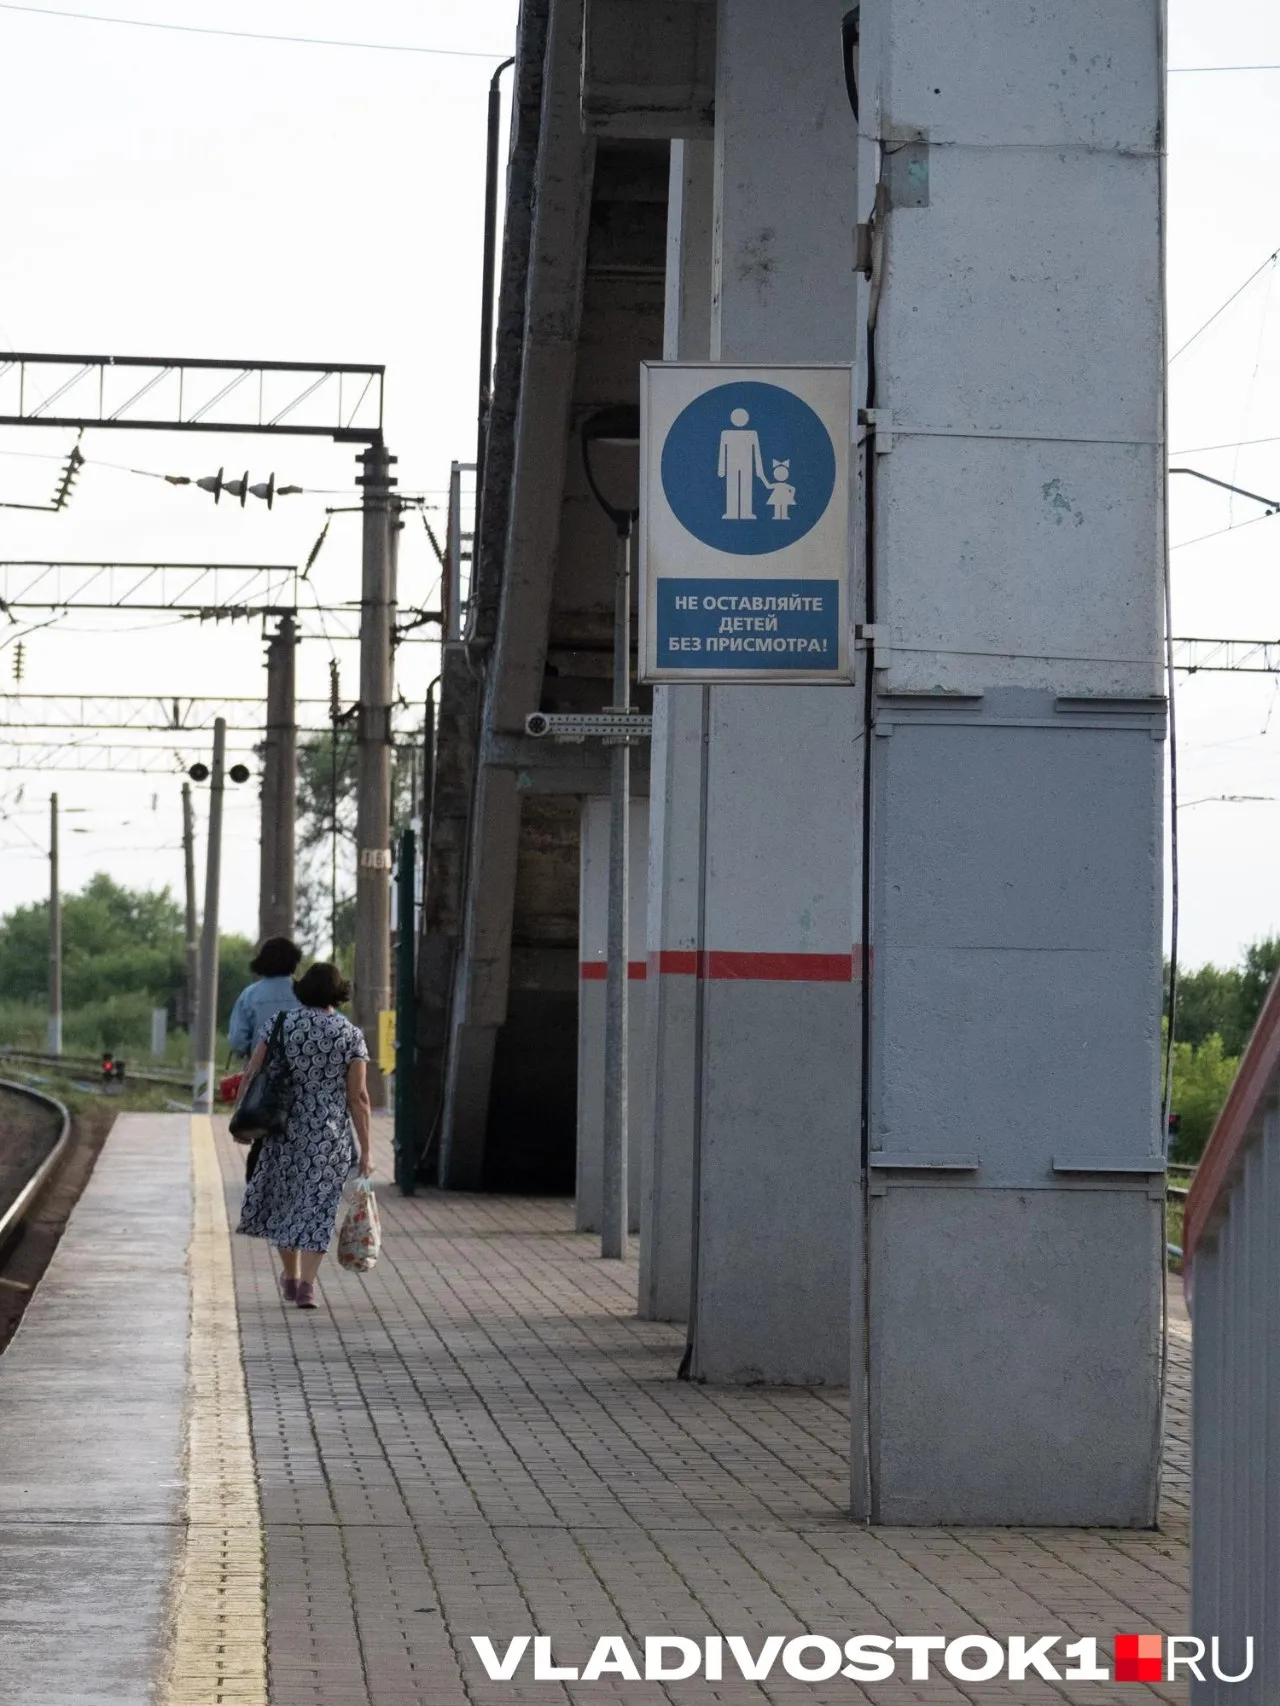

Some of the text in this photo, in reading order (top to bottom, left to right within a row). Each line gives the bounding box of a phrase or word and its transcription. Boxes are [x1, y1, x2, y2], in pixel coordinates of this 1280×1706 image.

[675, 594, 823, 612] НЕ ОСТАВЛЯЙТЕ
[718, 613, 777, 633] ДЕТЕЙ
[669, 637, 828, 652] БЕЗ ПРИСМОТРА!
